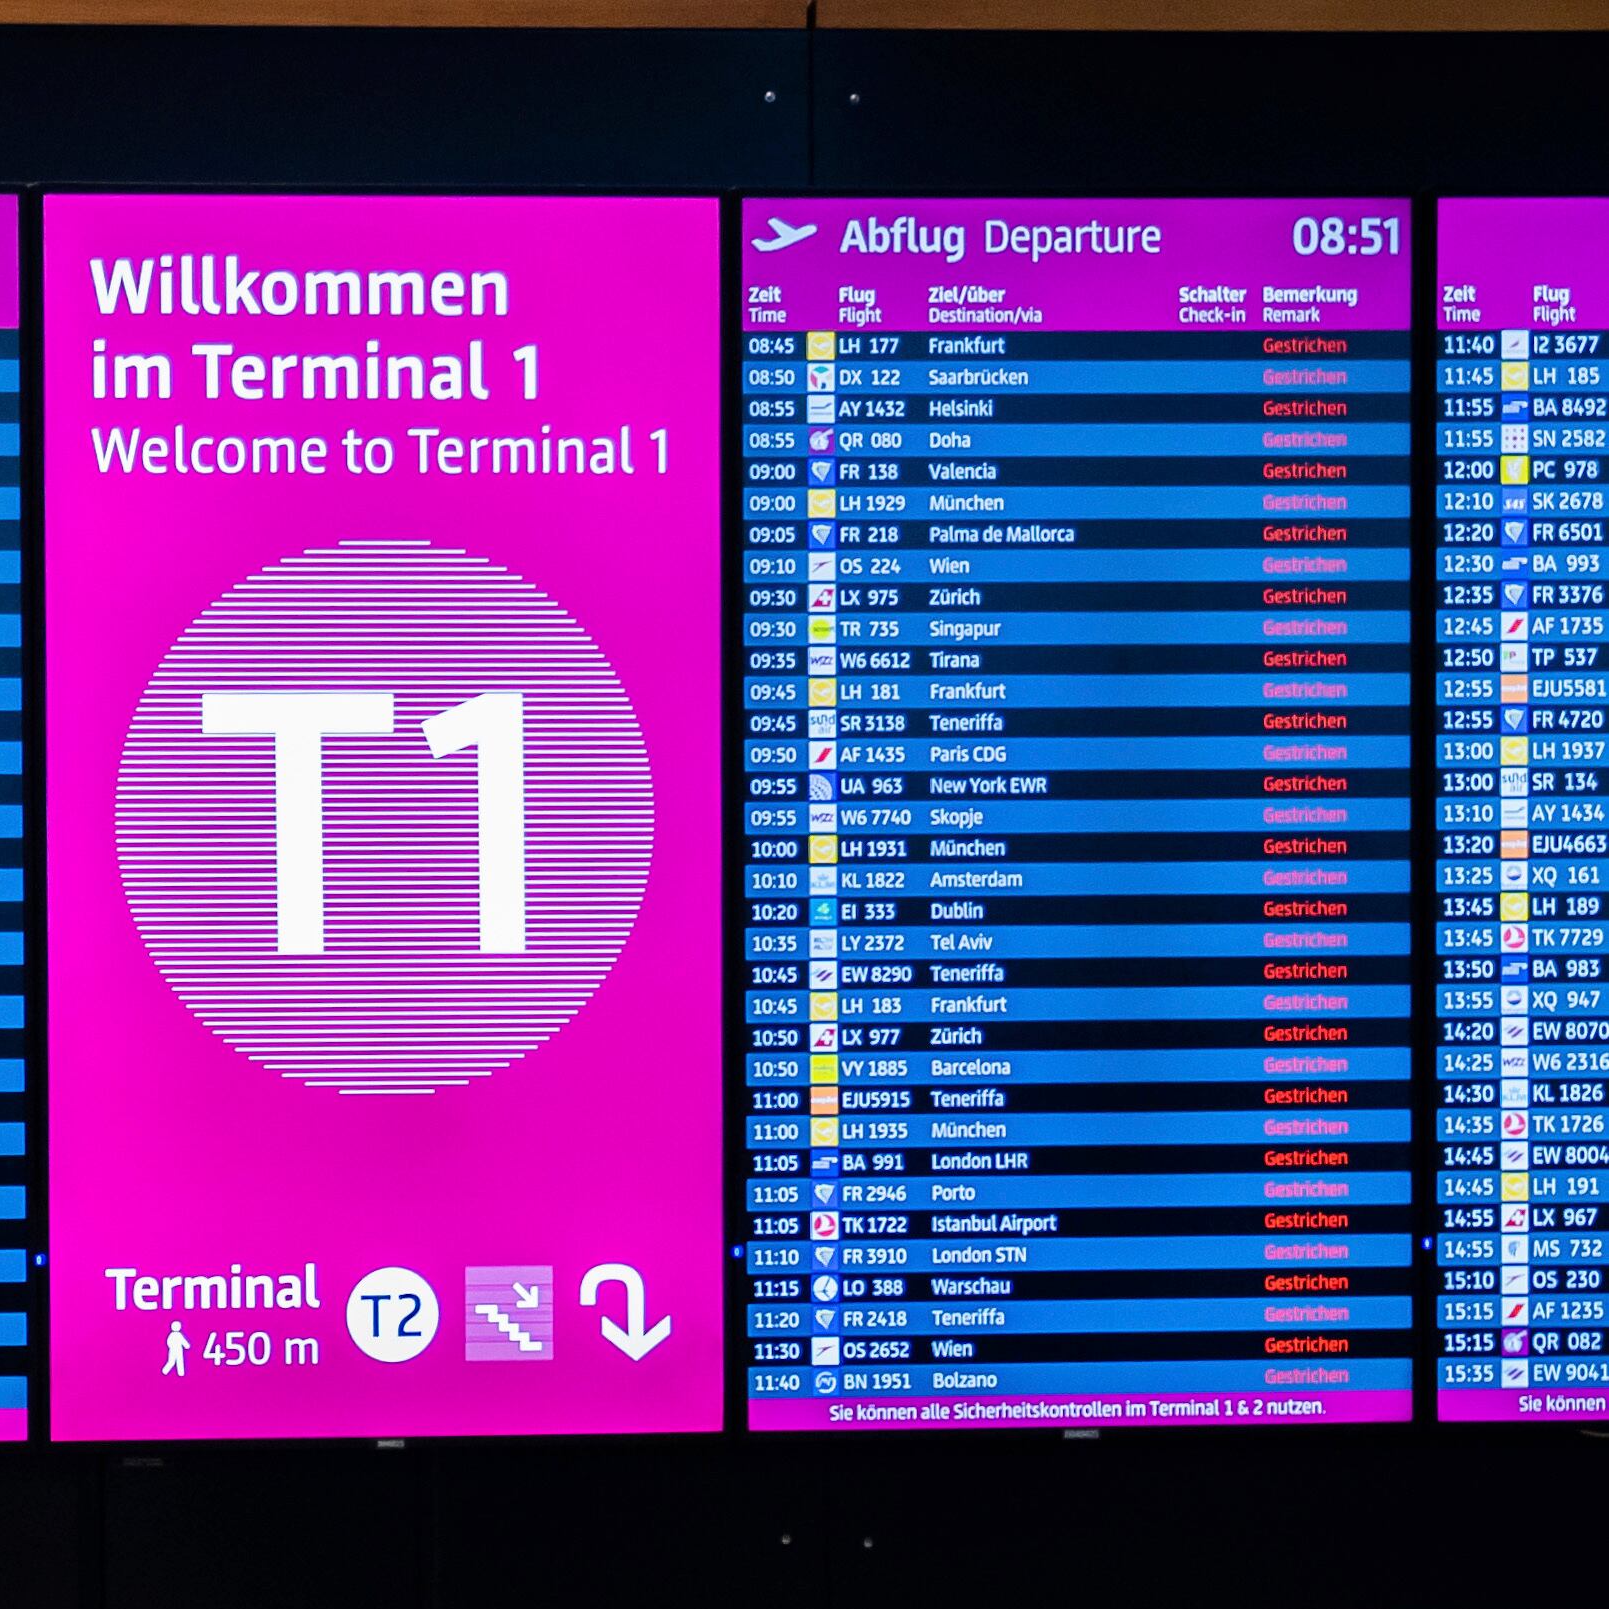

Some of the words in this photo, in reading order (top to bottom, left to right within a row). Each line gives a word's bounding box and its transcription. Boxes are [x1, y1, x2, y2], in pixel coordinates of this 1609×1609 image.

[839, 217, 965, 263] Abflug
[985, 219, 1161, 263] Departure
[1293, 217, 1400, 256] 08:51
[90, 254, 508, 316] Willkommen
[748, 337, 795, 354] 08:45
[839, 337, 860, 354] LH
[870, 337, 899, 354] 177
[929, 335, 1005, 354] Frankfurt
[1262, 336, 1348, 354] Gestrichen
[1444, 335, 1495, 354] 11:40
[1554, 335, 1599, 354] 3677
[93, 340, 171, 400] im
[191, 339, 489, 400] Terminal
[513, 345, 538, 400] 1
[91, 425, 327, 474] Welcome
[344, 429, 394, 474] to
[407, 424, 634, 475] Terminal
[649, 428, 668, 474] 1
[750, 778, 797, 795] 09:55
[840, 778, 865, 794] UA
[872, 778, 903, 794] 963
[930, 777, 966, 794] New
[969, 777, 1008, 794] York
[1010, 777, 1047, 794] EWR
[1263, 775, 1348, 792] Gestrichen
[202, 692, 526, 956] T1
[104, 1263, 321, 1311] Terminal
[360, 1293, 423, 1339] T2
[202, 1331, 271, 1366] 450
[285, 1337, 319, 1365] m
[755, 1374, 800, 1391] 11:40
[843, 1373, 868, 1390] BN
[872, 1373, 912, 1390] 1951
[933, 1371, 998, 1389] Bolzano
[1264, 1367, 1349, 1386] Gestrichen
[1445, 1364, 1494, 1383] 15:35
[1533, 1364, 1562, 1382] EW
[1565, 1363, 1609, 1381] 9041
